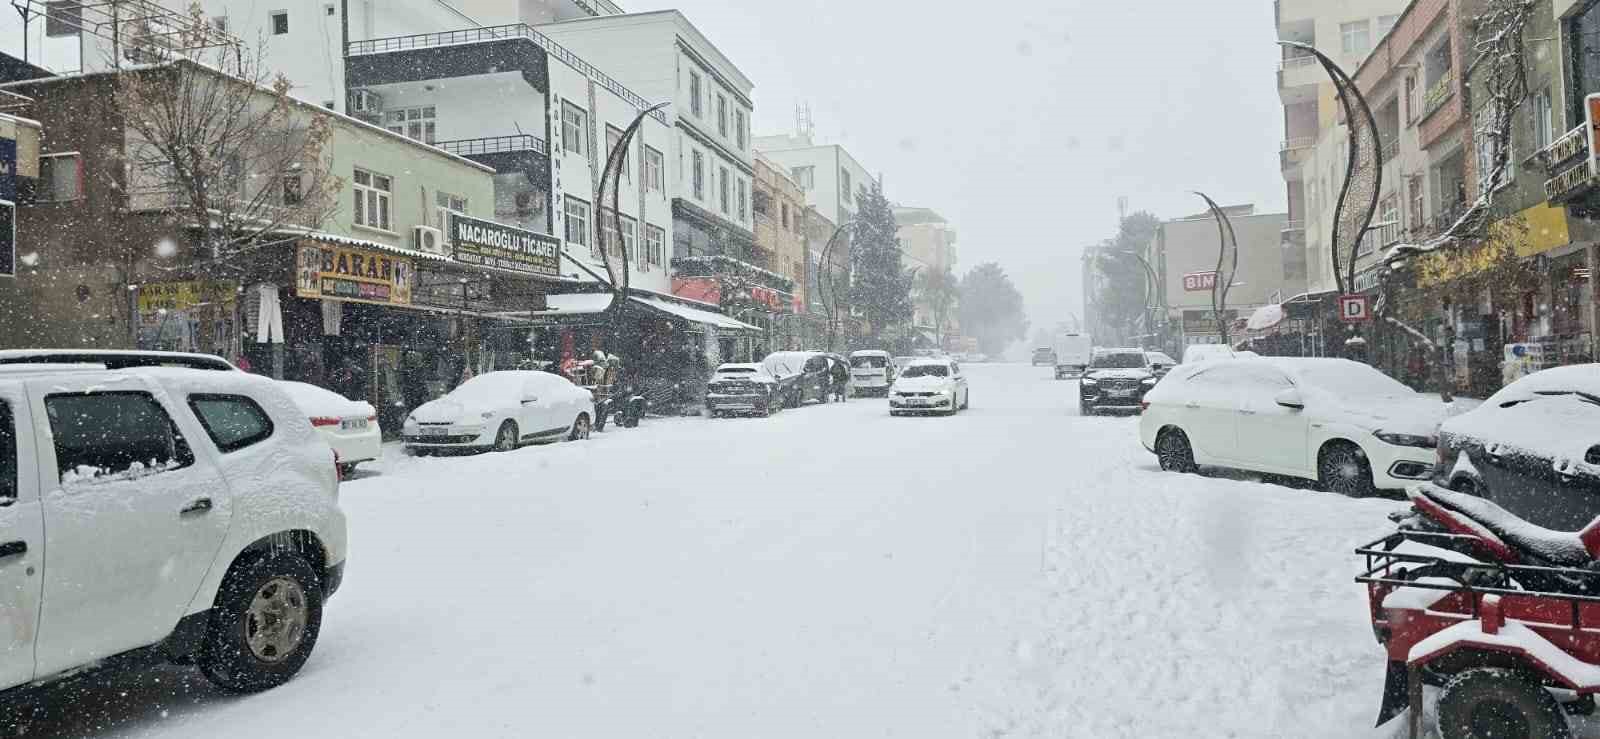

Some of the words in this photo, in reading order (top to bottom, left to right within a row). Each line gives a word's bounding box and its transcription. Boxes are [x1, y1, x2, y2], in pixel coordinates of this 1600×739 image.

[458, 222, 520, 252] NACAROĞLU
[521, 234, 557, 258] TİCARET
[321, 248, 391, 279] BARAN
[1349, 301, 1361, 315] D
